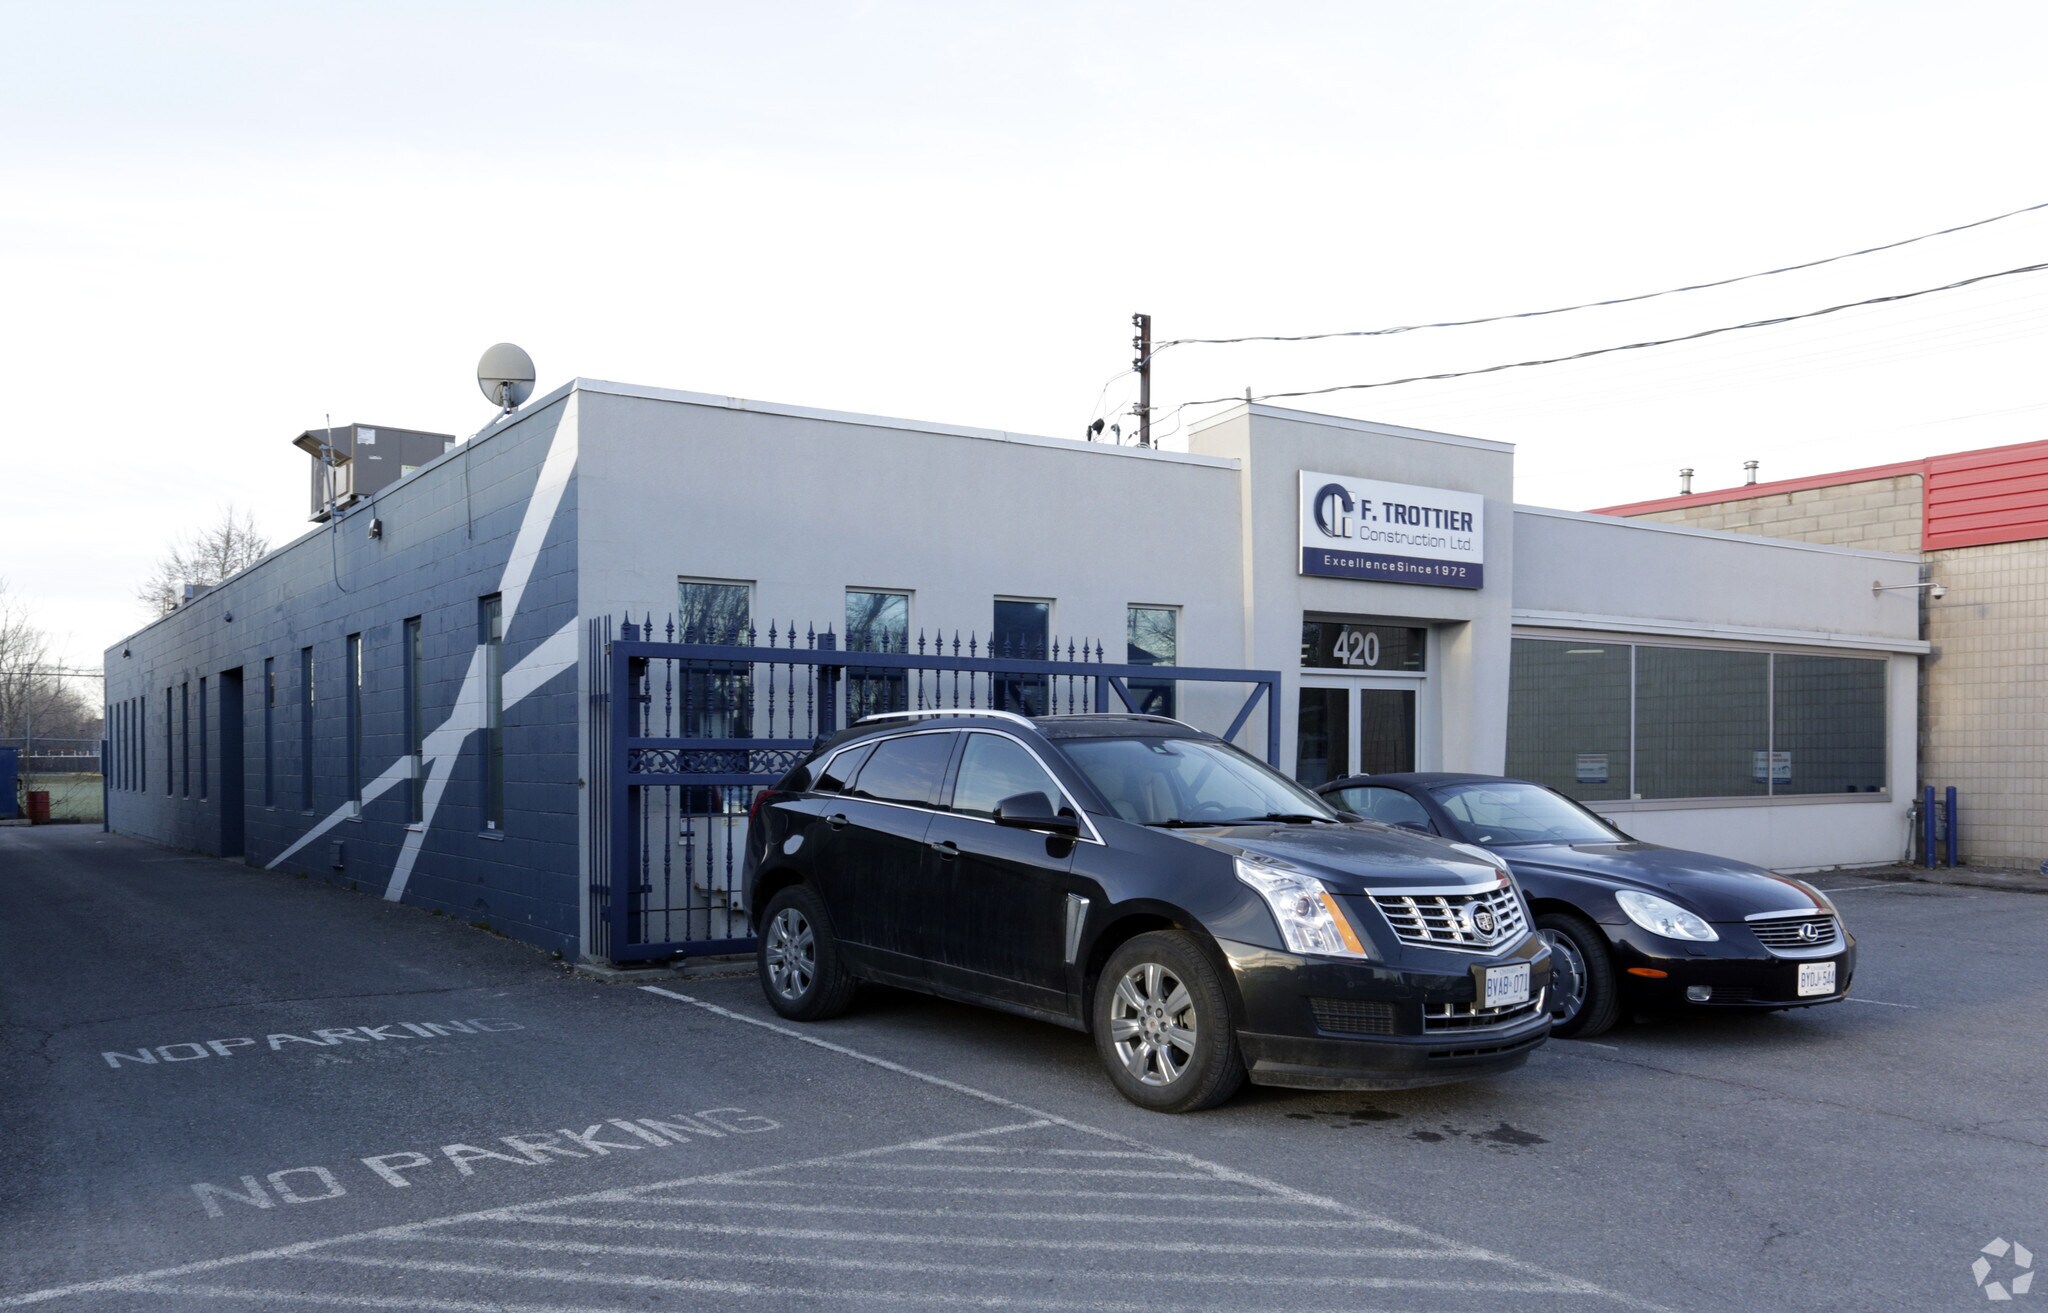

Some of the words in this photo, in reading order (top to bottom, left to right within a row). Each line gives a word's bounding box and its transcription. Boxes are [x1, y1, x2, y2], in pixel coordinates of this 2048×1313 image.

[1361, 499, 1377, 521] F.
[1382, 502, 1473, 532] TROTTIER
[1360, 525, 1446, 549] Construction
[1450, 536, 1474, 551] Ltd.
[1333, 631, 1379, 667] 420
[192, 1166, 347, 1218] NO
[361, 1107, 781, 1188] PARKING
